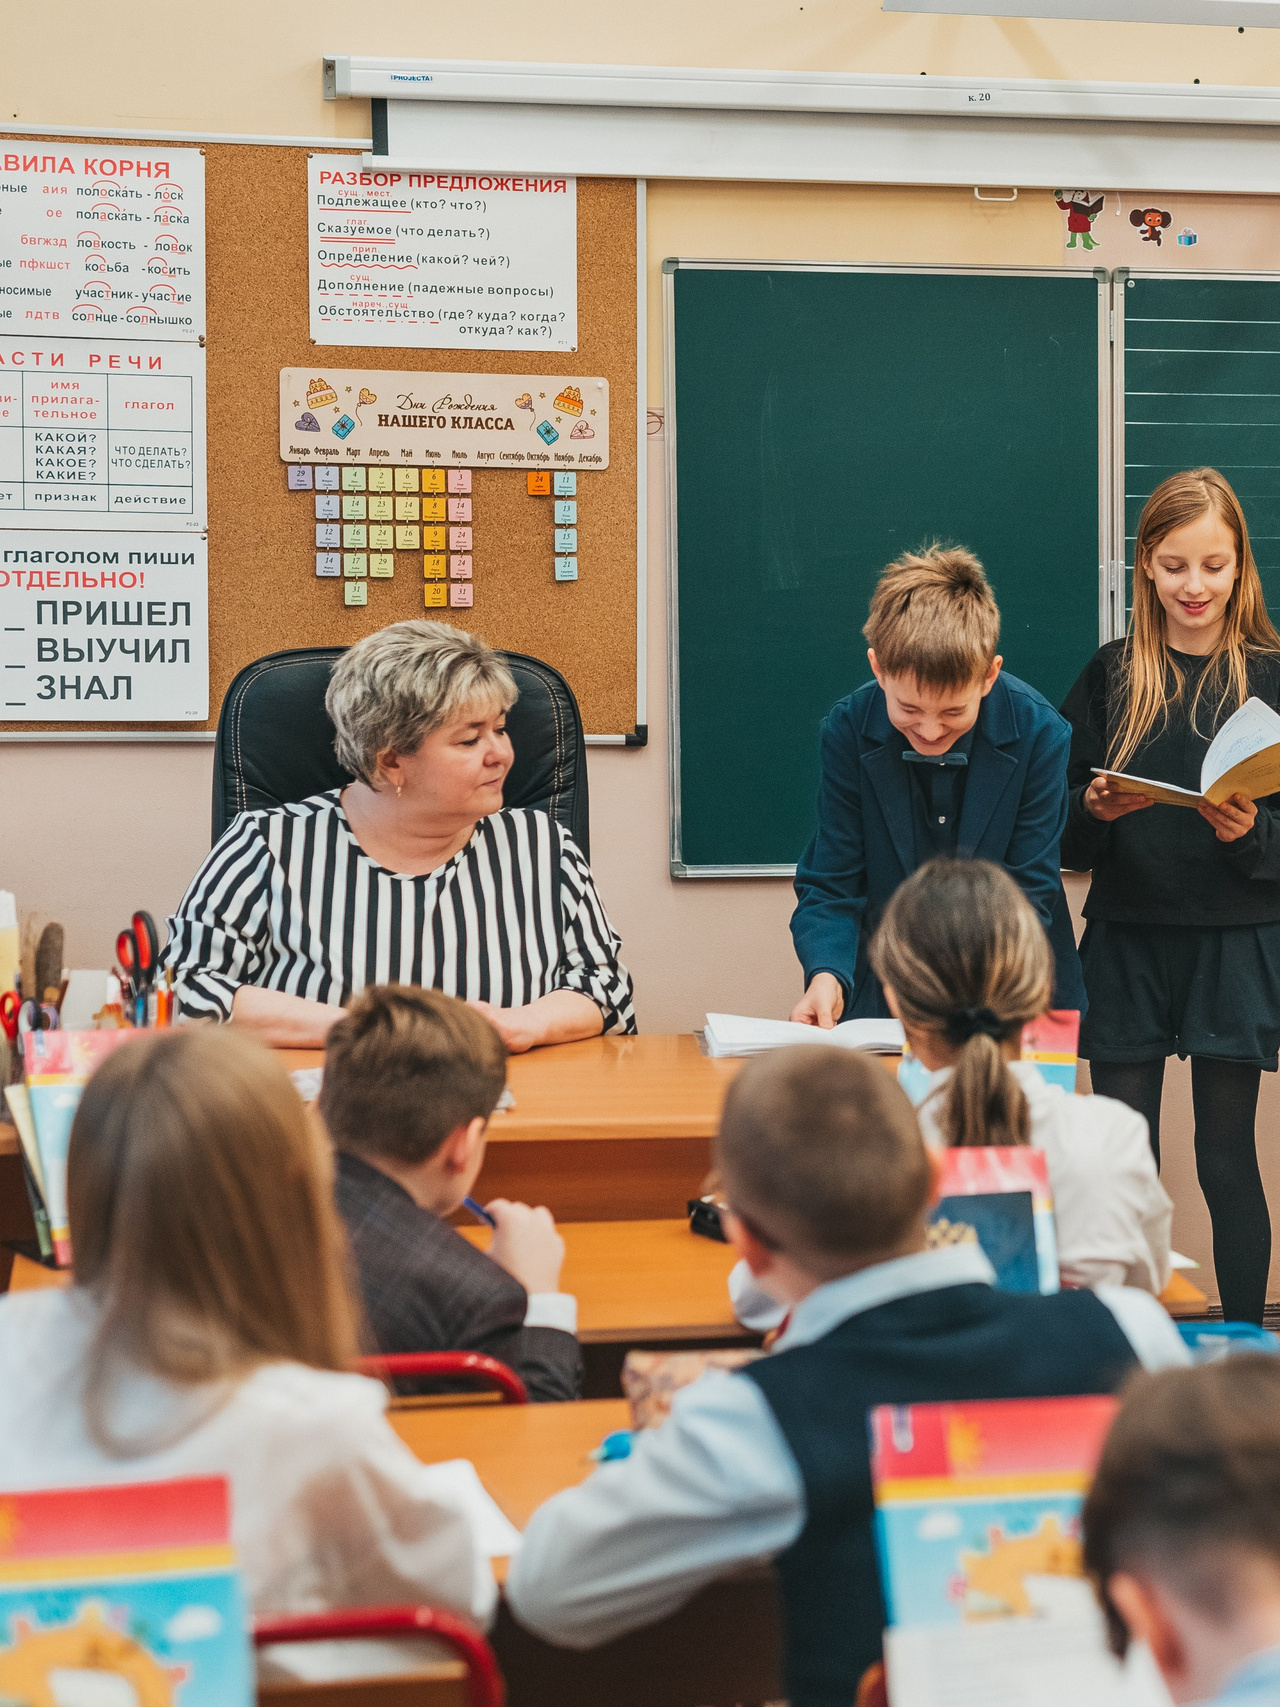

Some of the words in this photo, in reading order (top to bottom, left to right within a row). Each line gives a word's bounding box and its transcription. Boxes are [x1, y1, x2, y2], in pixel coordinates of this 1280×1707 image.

[979, 93, 991, 101] 20
[0, 154, 75, 175] ВИЛА
[84, 158, 170, 179] КОРНЯ
[319, 170, 401, 187] РАЗБОР
[408, 174, 567, 194] ПРЕДЛОЖЕНИЯ
[0, 183, 28, 193] ные
[367, 190, 393, 198] мест.
[317, 194, 407, 209] Подлежащее
[410, 198, 446, 211] (кто?
[450, 199, 487, 213] что?)
[346, 219, 369, 227] глаг.
[317, 223, 392, 236] Сказуемое
[395, 226, 424, 238] (что
[427, 227, 491, 241] делать?)
[20, 234, 68, 248] бвгжзд
[77, 239, 136, 250] ловкость
[155, 241, 193, 253] ловок
[352, 246, 380, 254] прил.
[317, 250, 413, 264] Определение
[416, 253, 469, 266] (какой?
[473, 256, 511, 269] чей?)
[19, 258, 71, 271] пфкшст
[85, 261, 129, 273] косьба
[148, 265, 191, 276] косить
[350, 274, 373, 282] сущ.
[317, 279, 404, 292] Дополнение
[408, 282, 484, 296] (падежные
[488, 286, 554, 299] вопросы)
[75, 288, 133, 300] участник
[141, 291, 192, 303] участие
[72, 312, 118, 324] солнце
[126, 314, 192, 326] солнышко
[318, 305, 435, 319] Обстоятельство
[438, 308, 474, 321] (где?
[477, 310, 517, 323] куда?
[520, 311, 566, 323] когда?
[459, 324, 514, 337] откуда?
[517, 326, 553, 339] как?)
[89, 354, 162, 370] РЕЧИ
[51, 382, 80, 390] имя
[31, 395, 100, 406] прилага-
[396, 392, 427, 412] Дни
[431, 393, 498, 414] Рождения
[124, 401, 175, 411] глагол
[33, 409, 97, 420] тельное
[377, 413, 447, 429] НАШЕГО
[451, 415, 515, 431] КЛАССА
[34, 431, 97, 443] КАКОЙ?
[35, 445, 96, 456] КАКАЯ?
[114, 446, 136, 455] ЧТО
[138, 447, 187, 457] ДЕЛАТЬ?
[288, 445, 310, 456] Январь
[314, 446, 339, 456] Февраль
[346, 447, 361, 457] Март
[368, 447, 390, 458] Апрель
[400, 448, 413, 458] Май
[425, 448, 441, 459] Июнь
[451, 449, 467, 459] Июль
[476, 450, 495, 460] Август
[499, 450, 525, 461] Сентябрь
[526, 451, 550, 462] Октябрь
[554, 453, 575, 463] Ноябрь
[578, 453, 602, 463] Декабрь
[35, 458, 96, 468] КАКОЕ?
[111, 459, 132, 468] ЧТО
[135, 459, 191, 470] СДЕЛАТЬ?
[36, 470, 96, 481] КАКИЕ?
[296, 470, 306, 478] 29
[325, 470, 330, 478] 4
[352, 470, 357, 478] 4
[379, 471, 384, 479] 2
[405, 472, 410, 480] 6
[458, 473, 463, 481] 3
[535, 475, 544, 483] 24
[562, 476, 570, 484] 11
[34, 493, 97, 503] признак
[114, 494, 187, 505] действие
[325, 499, 331, 507] 4
[377, 500, 386, 508] 23
[432, 502, 437, 510] 8
[352, 528, 361, 536] 16
[378, 529, 387, 537] 24
[404, 529, 413, 537] 16
[433, 530, 438, 538] 9
[457, 531, 466, 539] 24
[3, 550, 119, 565] глаголом
[128, 552, 195, 565] пиши
[325, 556, 334, 564] 14
[352, 557, 360, 565] 17
[457, 559, 466, 567] 24
[0, 570, 145, 591] ОТДЕЛЬНО!
[352, 585, 361, 593] 31
[432, 587, 441, 595] 20
[458, 587, 466, 595] 31
[36, 600, 191, 627] ПРИШЕЛ
[36, 637, 190, 664] ВЫУЧИЛ
[36, 674, 132, 700] ЗНАЛ
